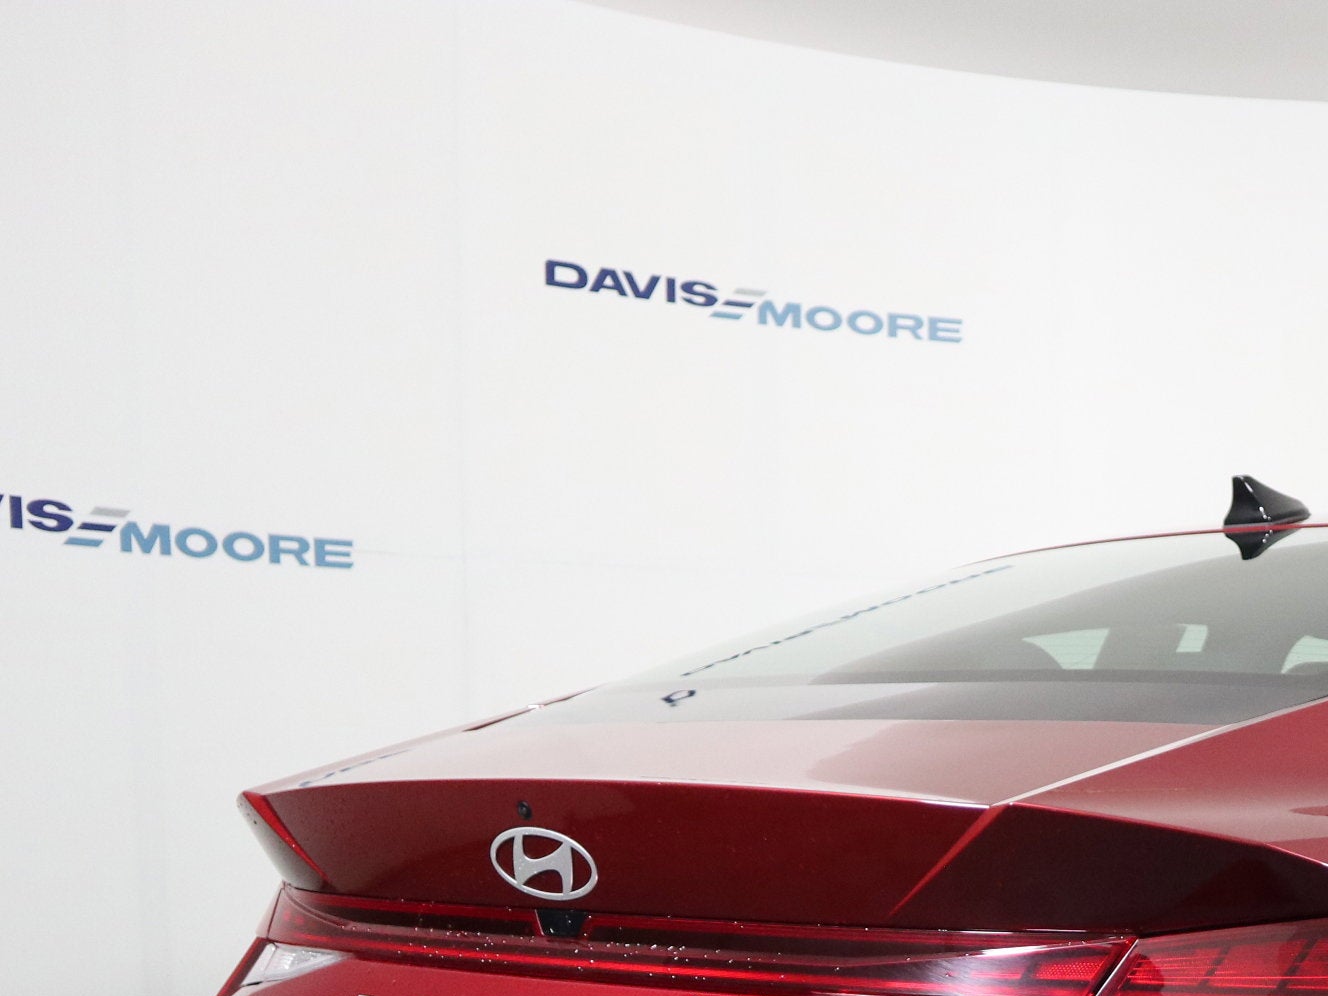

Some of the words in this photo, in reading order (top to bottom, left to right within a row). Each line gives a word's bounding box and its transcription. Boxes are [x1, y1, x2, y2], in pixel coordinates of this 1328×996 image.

[543, 258, 719, 309] DAVIS
[757, 299, 963, 344] MOORE
[0, 493, 75, 534] IS
[118, 520, 355, 571] MOORE
